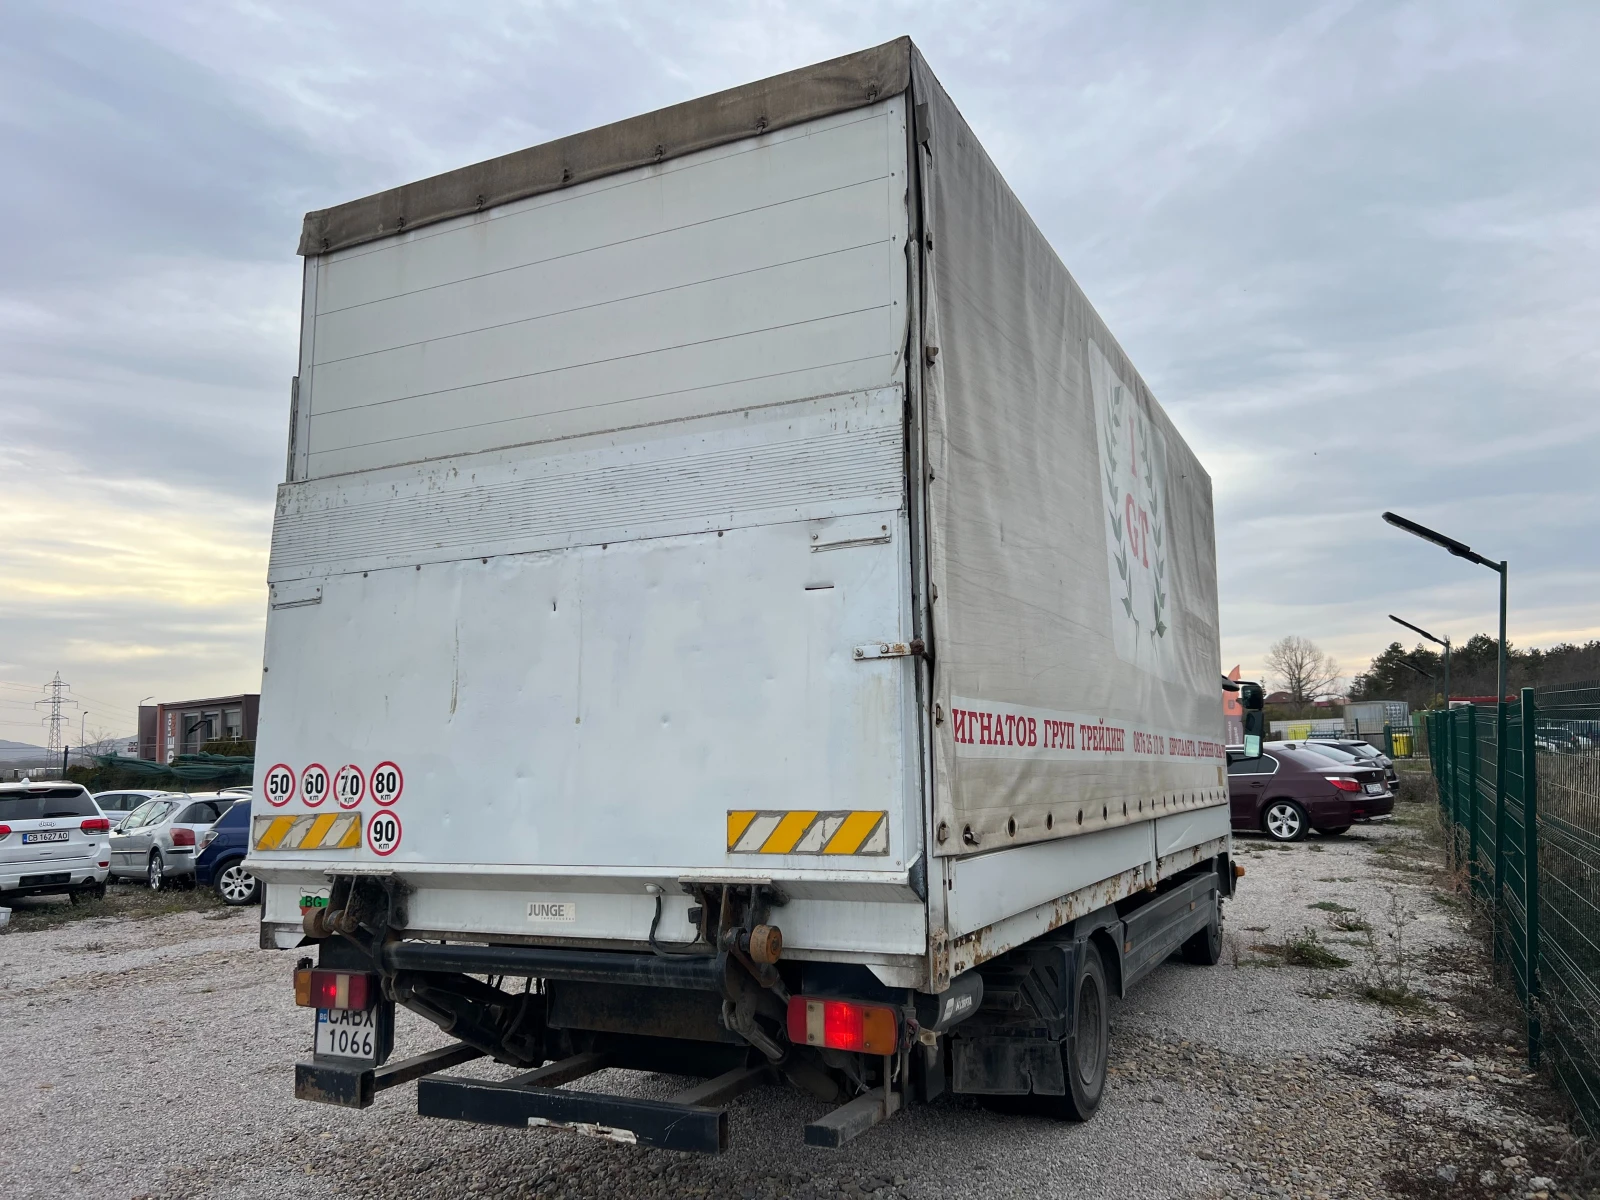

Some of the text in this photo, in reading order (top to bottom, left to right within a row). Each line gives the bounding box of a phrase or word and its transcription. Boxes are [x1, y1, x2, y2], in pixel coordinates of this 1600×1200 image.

[1125, 493, 1149, 569] GT
[952, 708, 1037, 747] ИГНАТОВ
[1043, 719, 1075, 750] ГРУП
[1079, 717, 1126, 755] ТРЕЙДИНГ
[269, 773, 290, 795] 50
[305, 773, 325, 795] 60
[340, 774, 360, 797] 70
[375, 771, 397, 794] 80
[373, 820, 396, 843] 90
[304, 895, 323, 908] BG
[528, 904, 565, 917] JUNGE
[319, 1012, 328, 1020] BG
[329, 1028, 373, 1056] 1066
